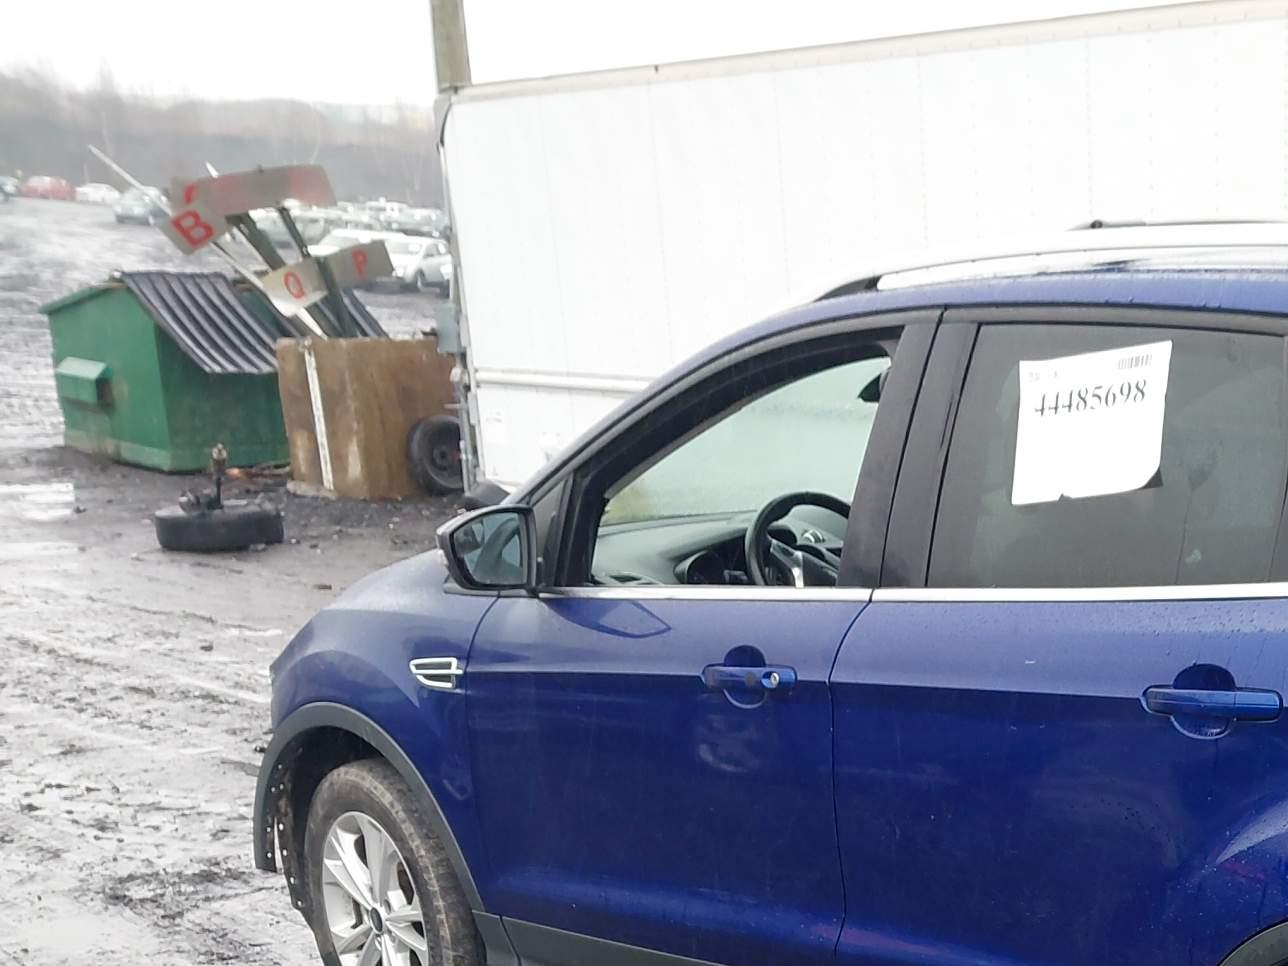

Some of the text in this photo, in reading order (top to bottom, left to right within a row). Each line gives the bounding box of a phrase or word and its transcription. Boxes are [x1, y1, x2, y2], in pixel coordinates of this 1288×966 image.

[170, 210, 214, 248] B
[352, 249, 369, 278] P
[1034, 379, 1147, 416] 44485698
